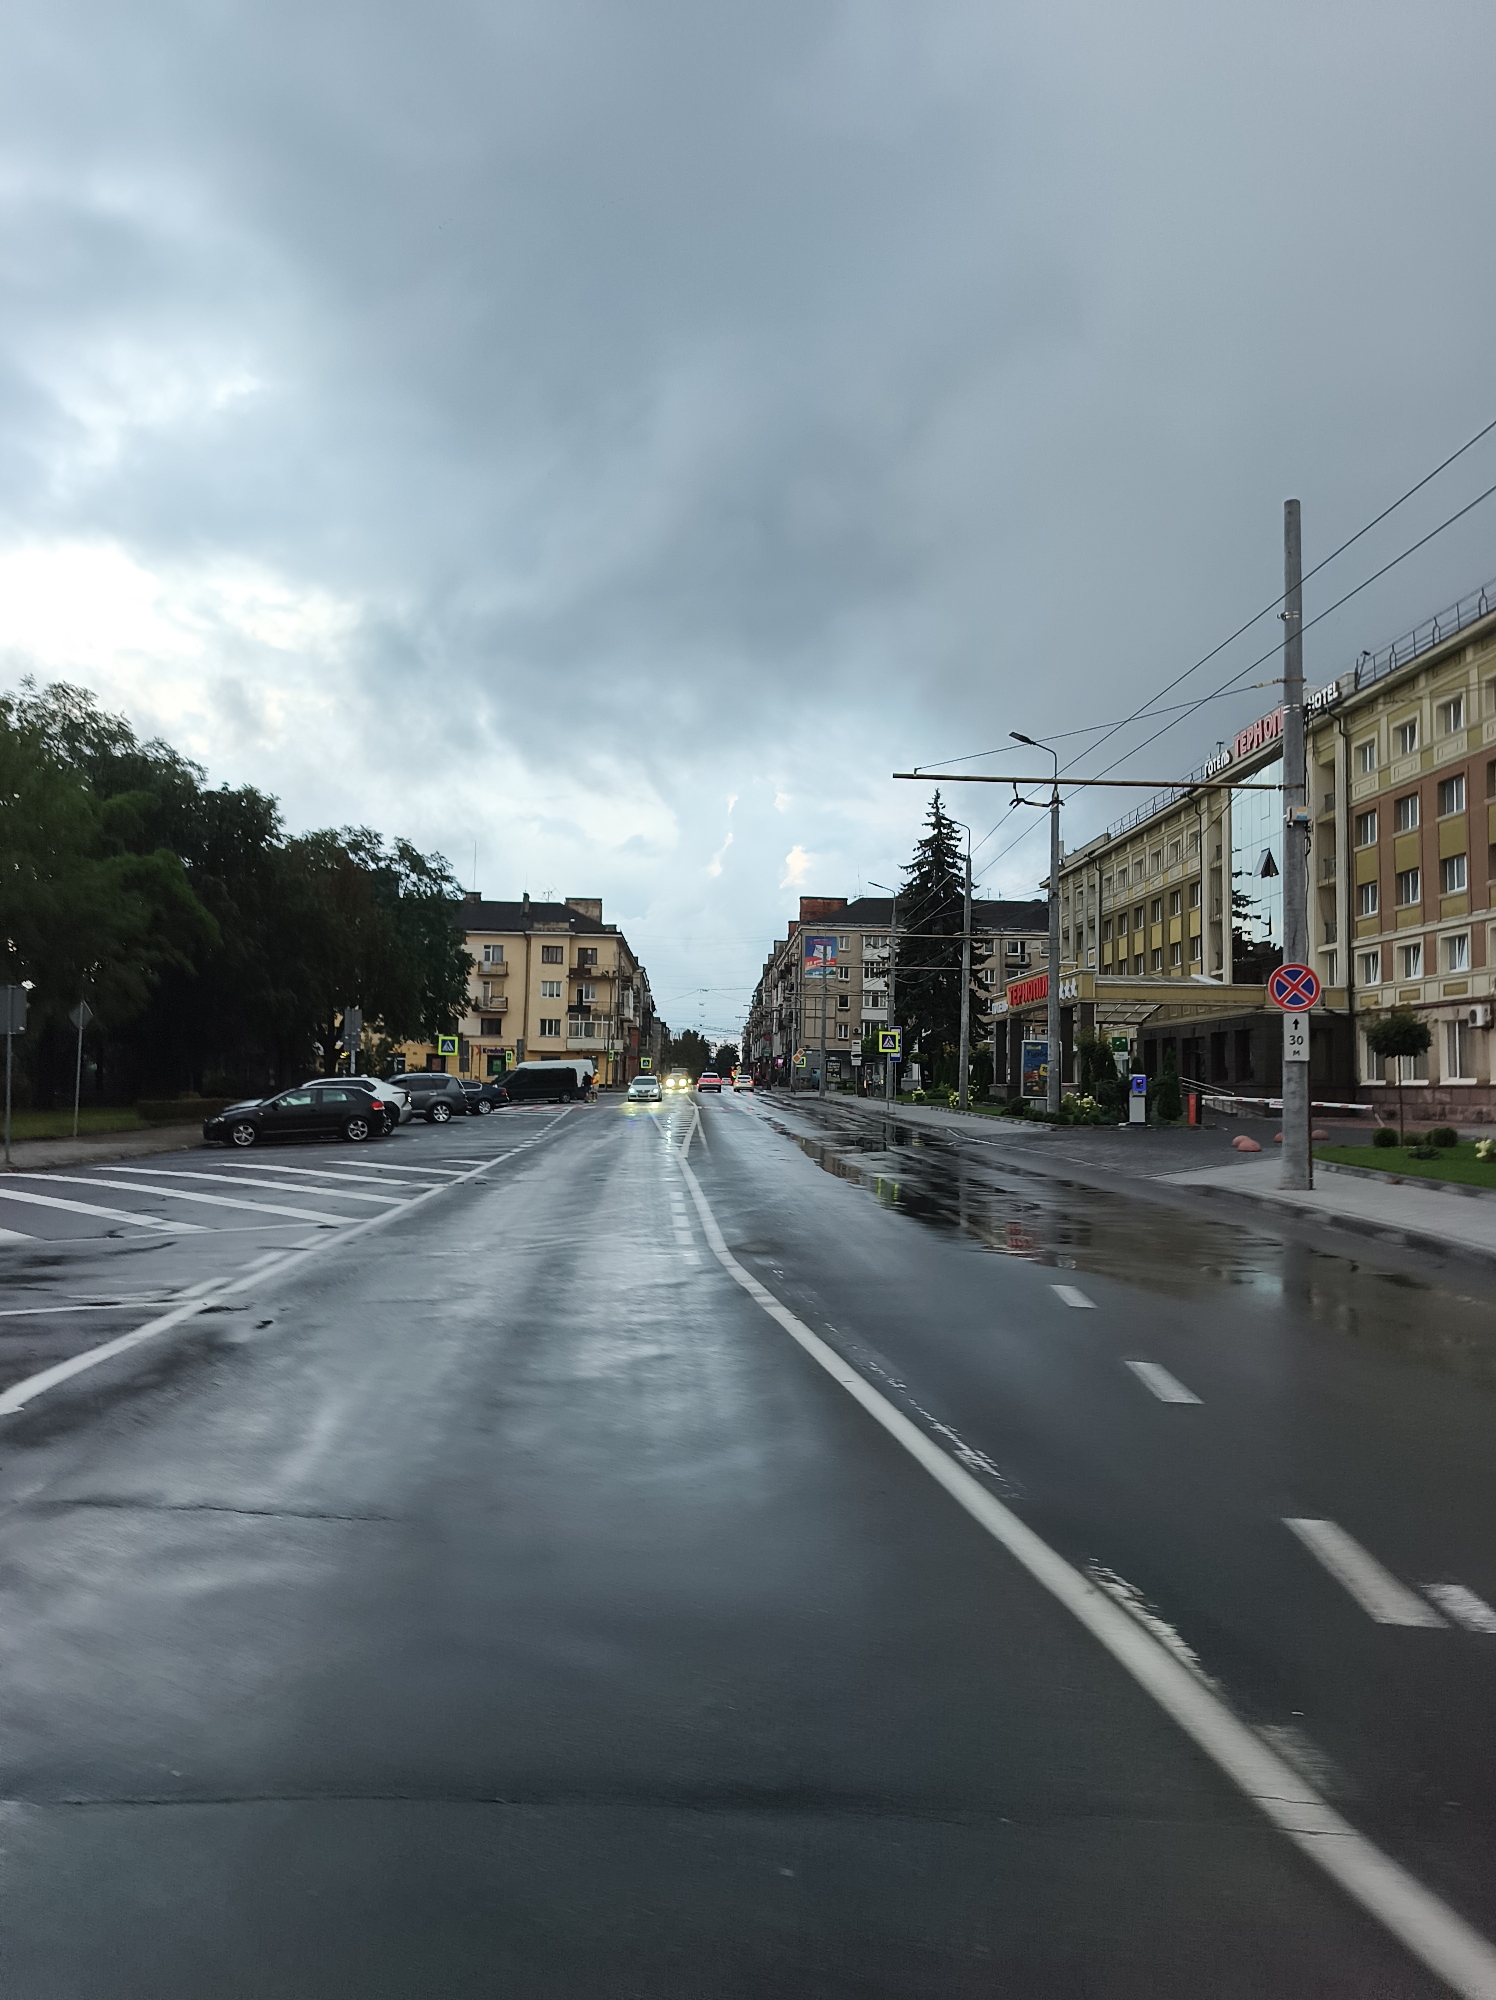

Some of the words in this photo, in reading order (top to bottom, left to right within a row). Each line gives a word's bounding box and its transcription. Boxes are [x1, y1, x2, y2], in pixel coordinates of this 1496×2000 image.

[1307, 681, 1339, 710] HOTEL
[1204, 750, 1231, 778] ГОТЕЛЬ
[1234, 705, 1284, 757] ТЕРНОПІ
[1008, 975, 1049, 1006] ТЕРНОПІЛ
[1289, 1035, 1304, 1045] 30
